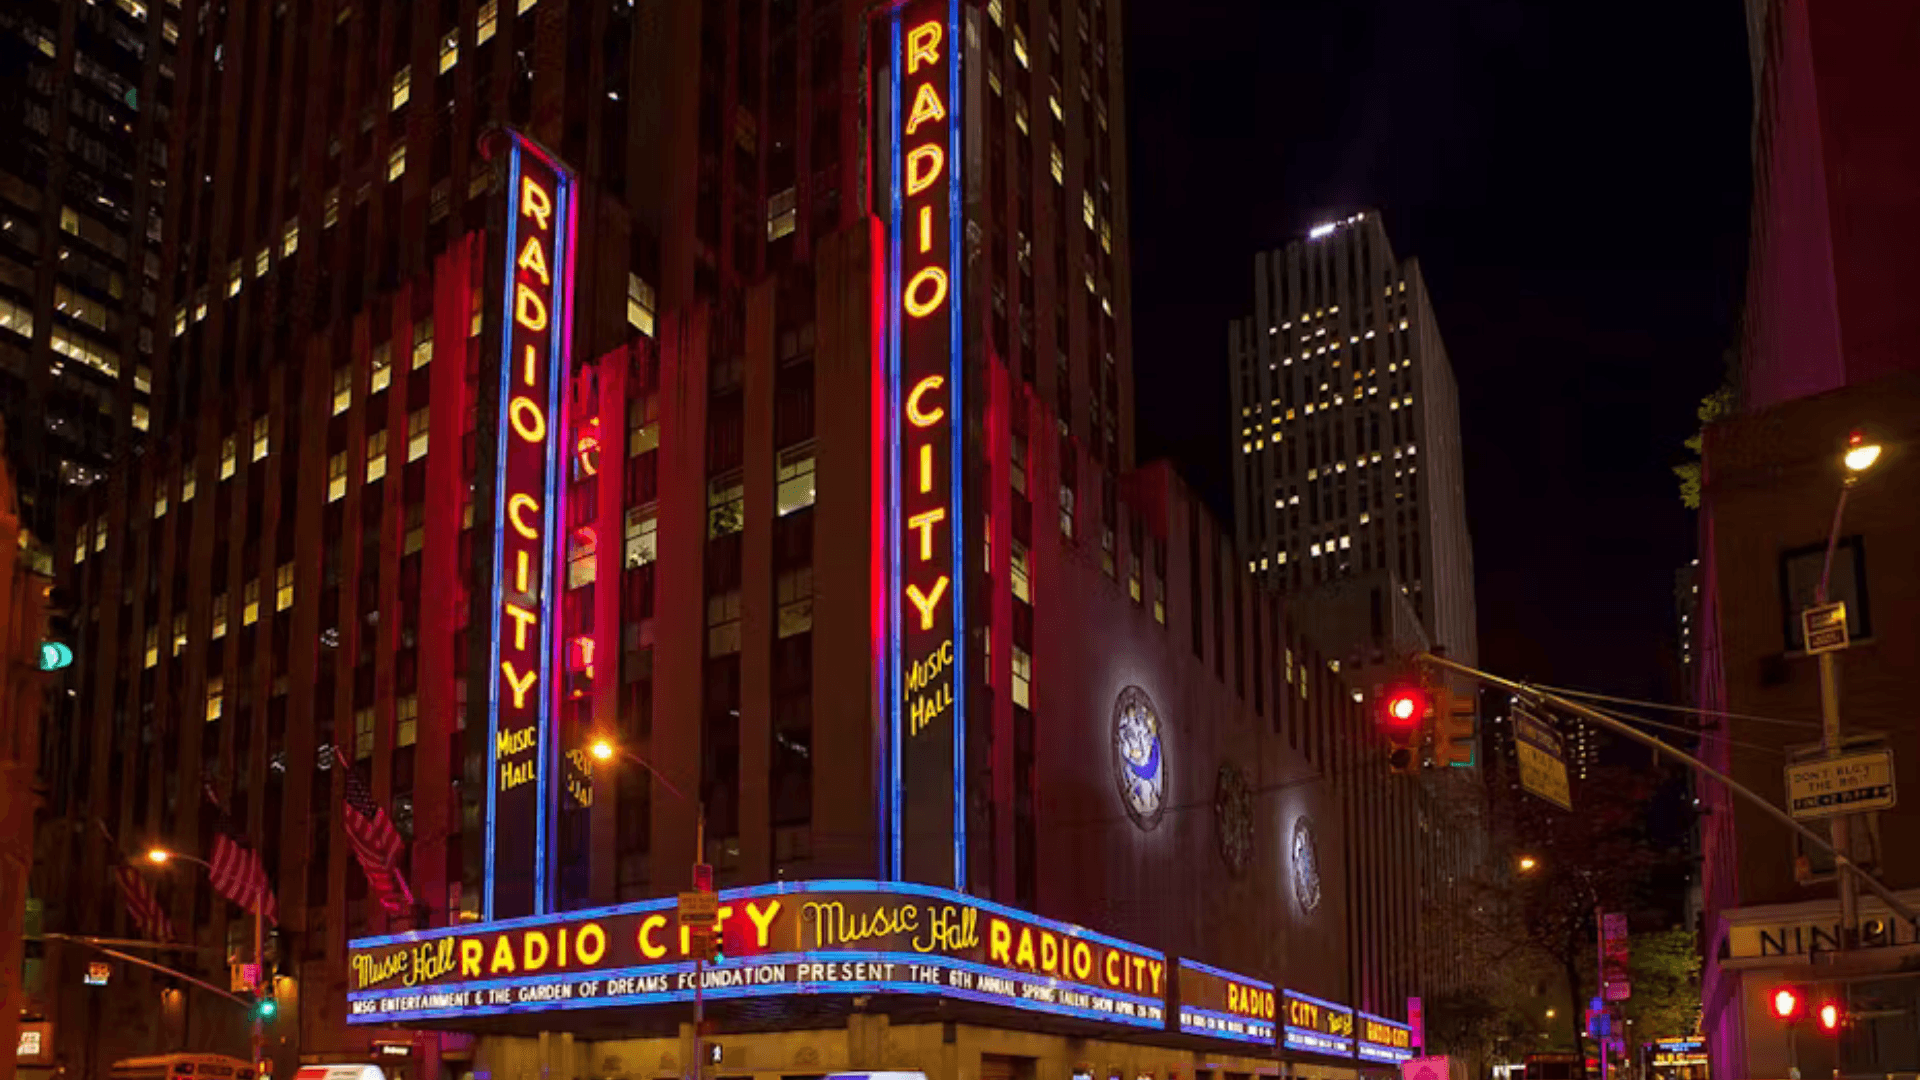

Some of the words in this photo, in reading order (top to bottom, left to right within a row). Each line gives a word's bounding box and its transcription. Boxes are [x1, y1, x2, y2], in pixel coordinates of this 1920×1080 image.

[903, 20, 948, 318] RADIO
[509, 174, 551, 443] RADIO
[501, 492, 539, 709] CITY
[905, 374, 950, 631] CITY
[352, 951, 408, 990] Music
[402, 936, 458, 987] Hall
[460, 922, 606, 978] RADIO
[802, 901, 919, 949] Music
[911, 906, 980, 953] Hall
[989, 917, 1092, 980] RADIO
[1105, 948, 1162, 995] CITY
[352, 1000, 377, 1015] MSG
[380, 991, 470, 1012] ENTERTAINMENT
[489, 987, 512, 1006] THE
[518, 983, 573, 1003] GARDEN
[579, 980, 600, 998] OF
[606, 973, 669, 996] DREAMS
[797, 963, 895, 983] PRESENT
[909, 964, 941, 985] THE
[949, 969, 972, 989] 6TH
[1227, 981, 1275, 1020] RADIO
[1291, 999, 1319, 1029] CITY
